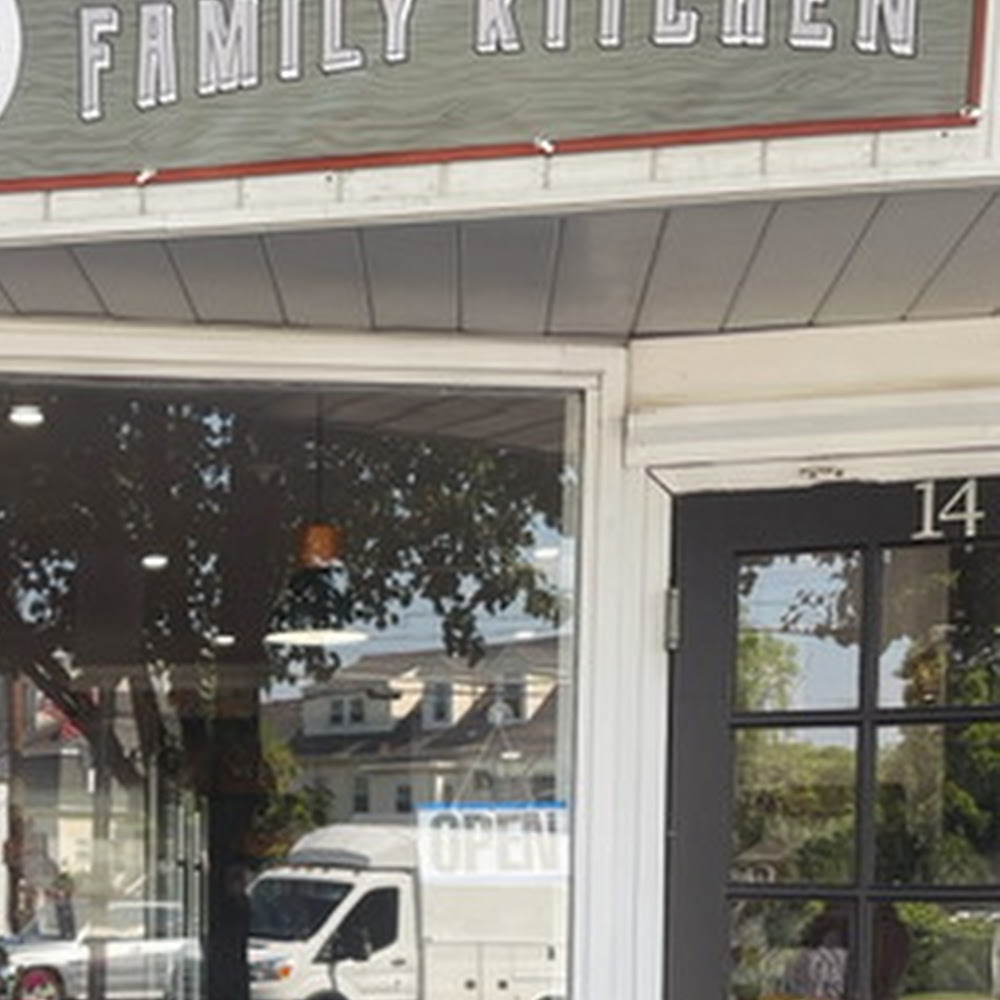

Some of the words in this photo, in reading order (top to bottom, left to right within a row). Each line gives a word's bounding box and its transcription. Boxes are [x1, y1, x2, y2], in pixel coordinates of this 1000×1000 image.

[79, 0, 415, 121] FAMILY
[910, 477, 986, 540] 14
[430, 811, 558, 873] OPEN
